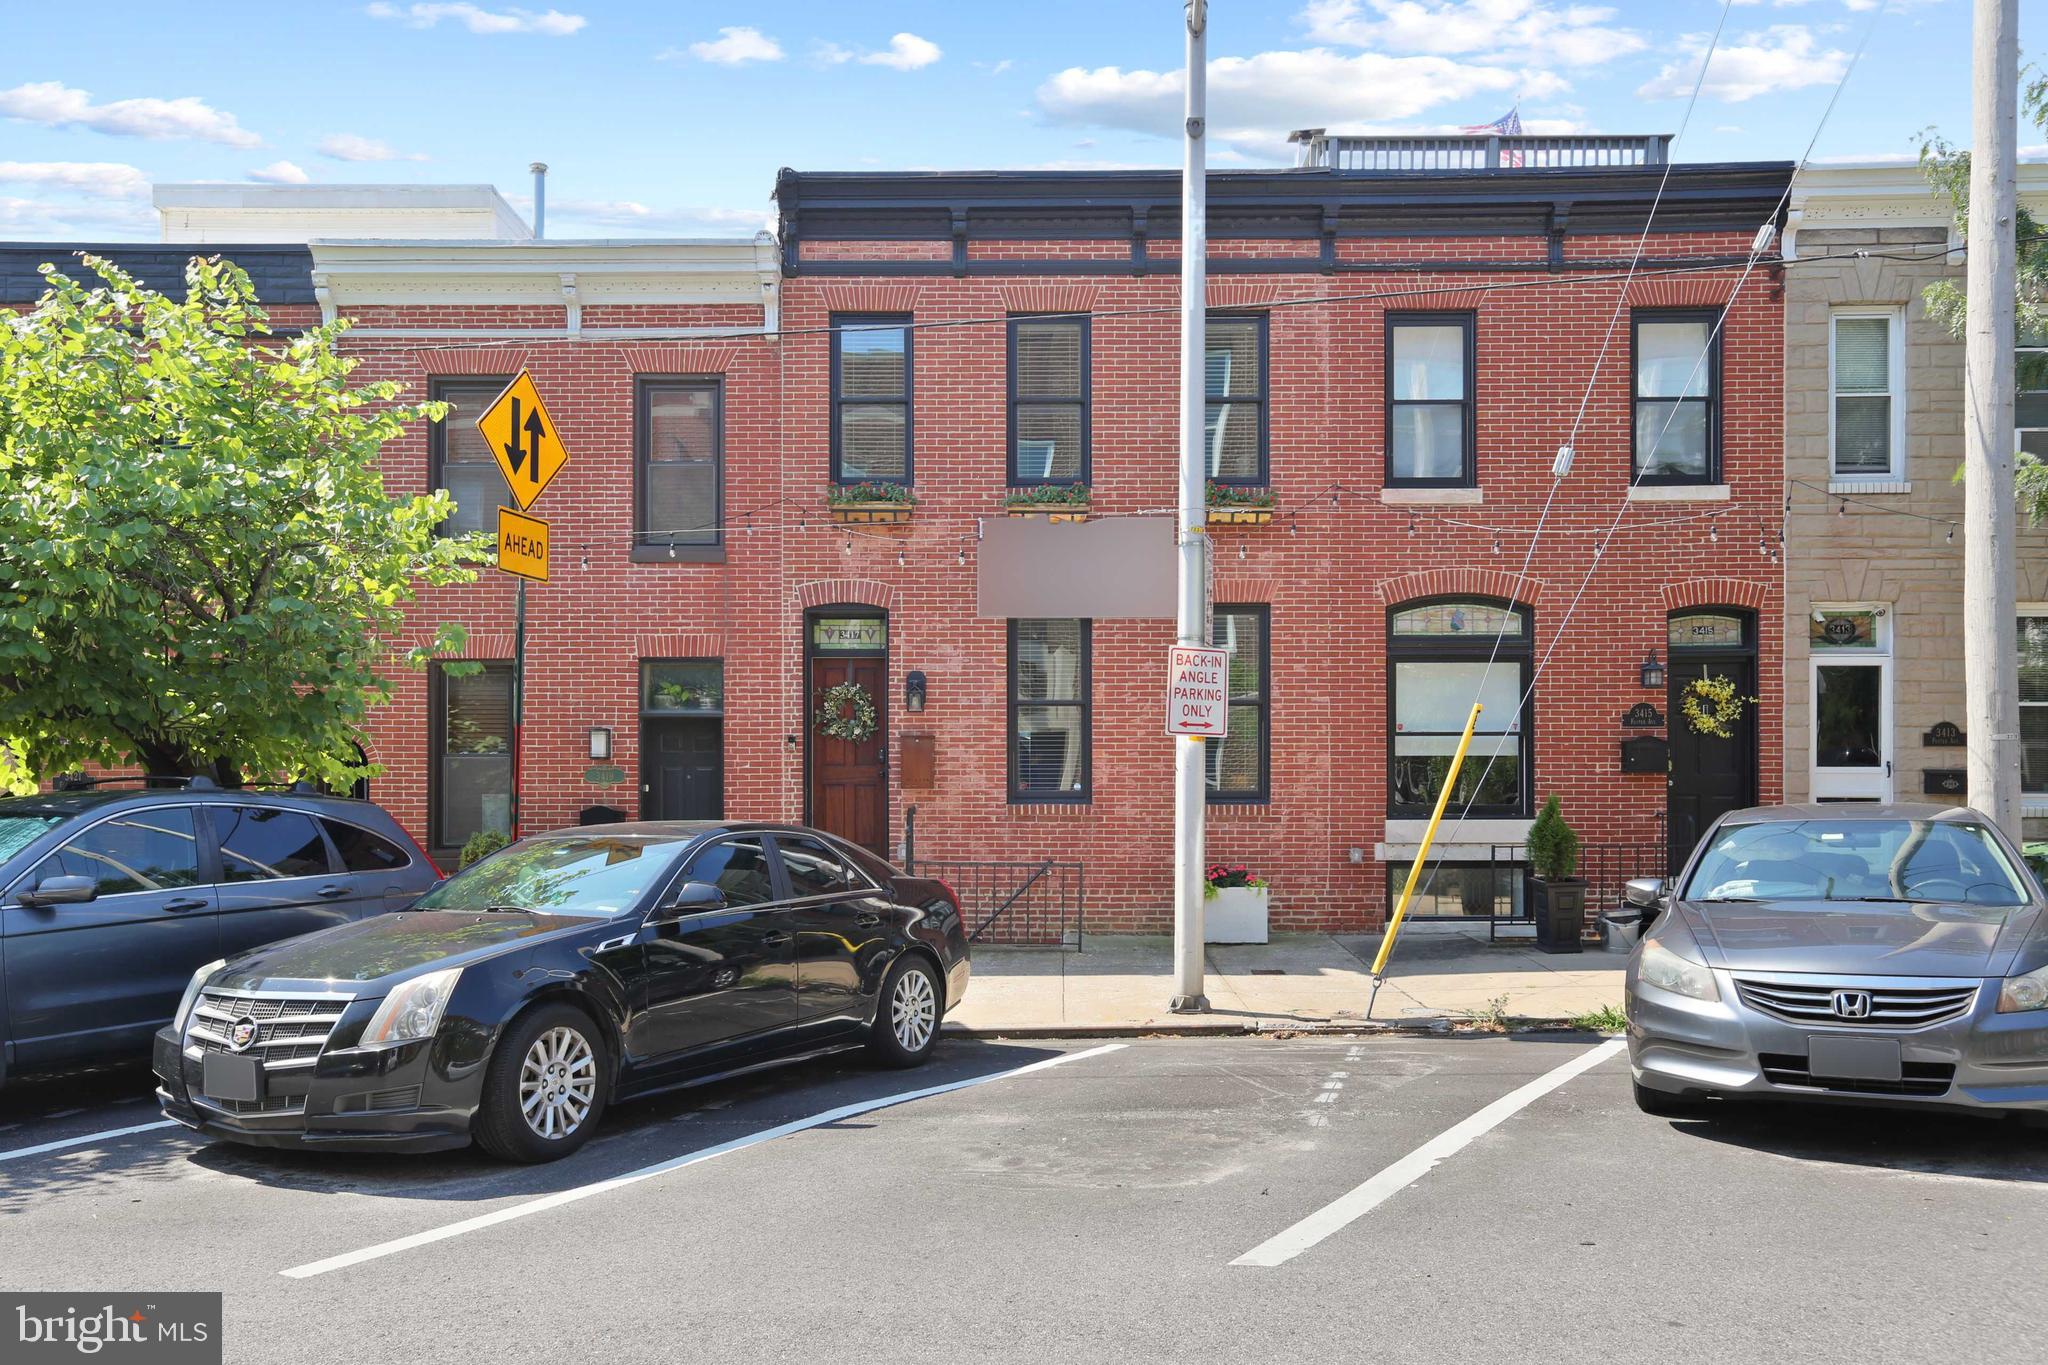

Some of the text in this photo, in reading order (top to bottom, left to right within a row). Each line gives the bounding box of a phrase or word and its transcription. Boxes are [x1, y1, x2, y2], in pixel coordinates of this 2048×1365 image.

[504, 532, 544, 560] AHEAD
[839, 630, 861, 639] 3417
[1692, 626, 1714, 635] 3415
[1829, 624, 1851, 633] 3413
[1176, 653, 1222, 668] BACK-IN
[1179, 670, 1218, 684] ANGLE
[1174, 687, 1222, 701] PARKING
[1182, 704, 1212, 718] ONLY
[1634, 708, 1653, 718] 3415
[1936, 727, 1956, 737] 3413
